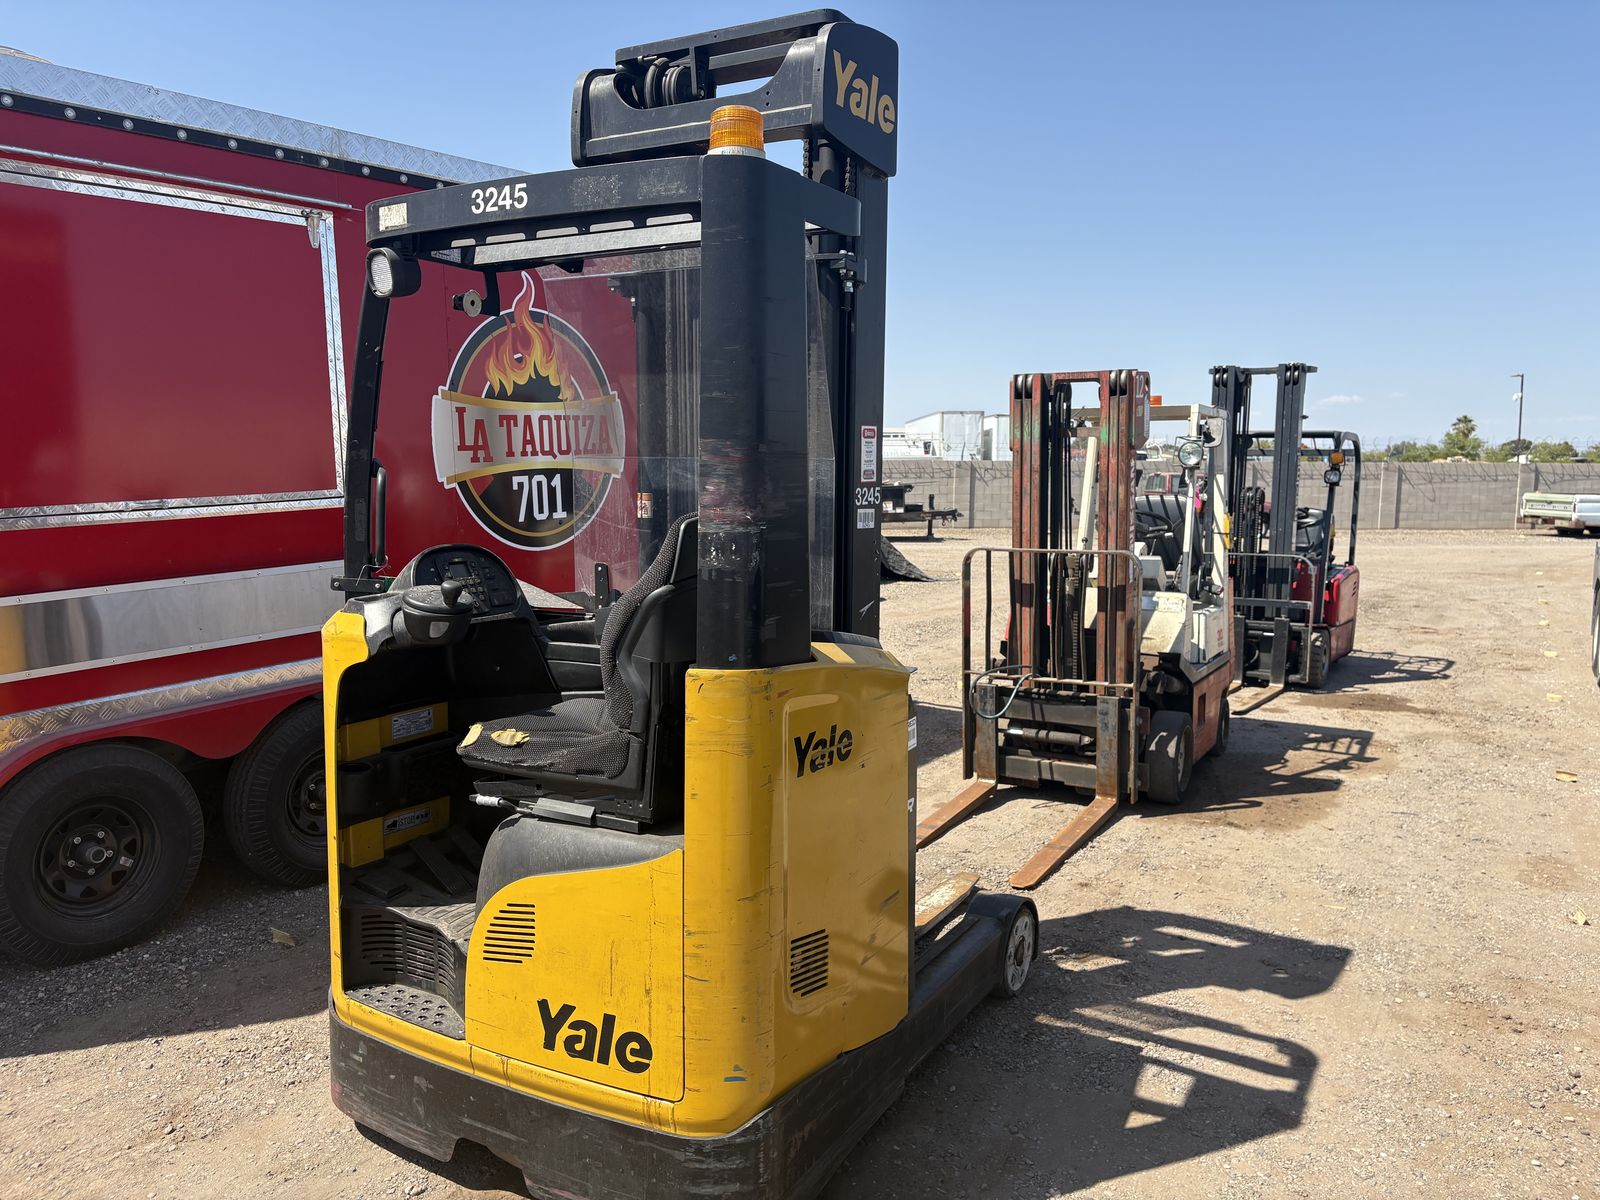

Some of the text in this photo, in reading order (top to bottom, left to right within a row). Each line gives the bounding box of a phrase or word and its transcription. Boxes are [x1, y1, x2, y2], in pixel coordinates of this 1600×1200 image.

[832, 49, 895, 134] Yale
[471, 183, 528, 214] 3245
[455, 407, 613, 463] LA TAQUIZA
[512, 473, 567, 523] 701
[855, 487, 881, 506] 3245
[794, 724, 853, 778] Yale
[537, 998, 653, 1074] Yale
